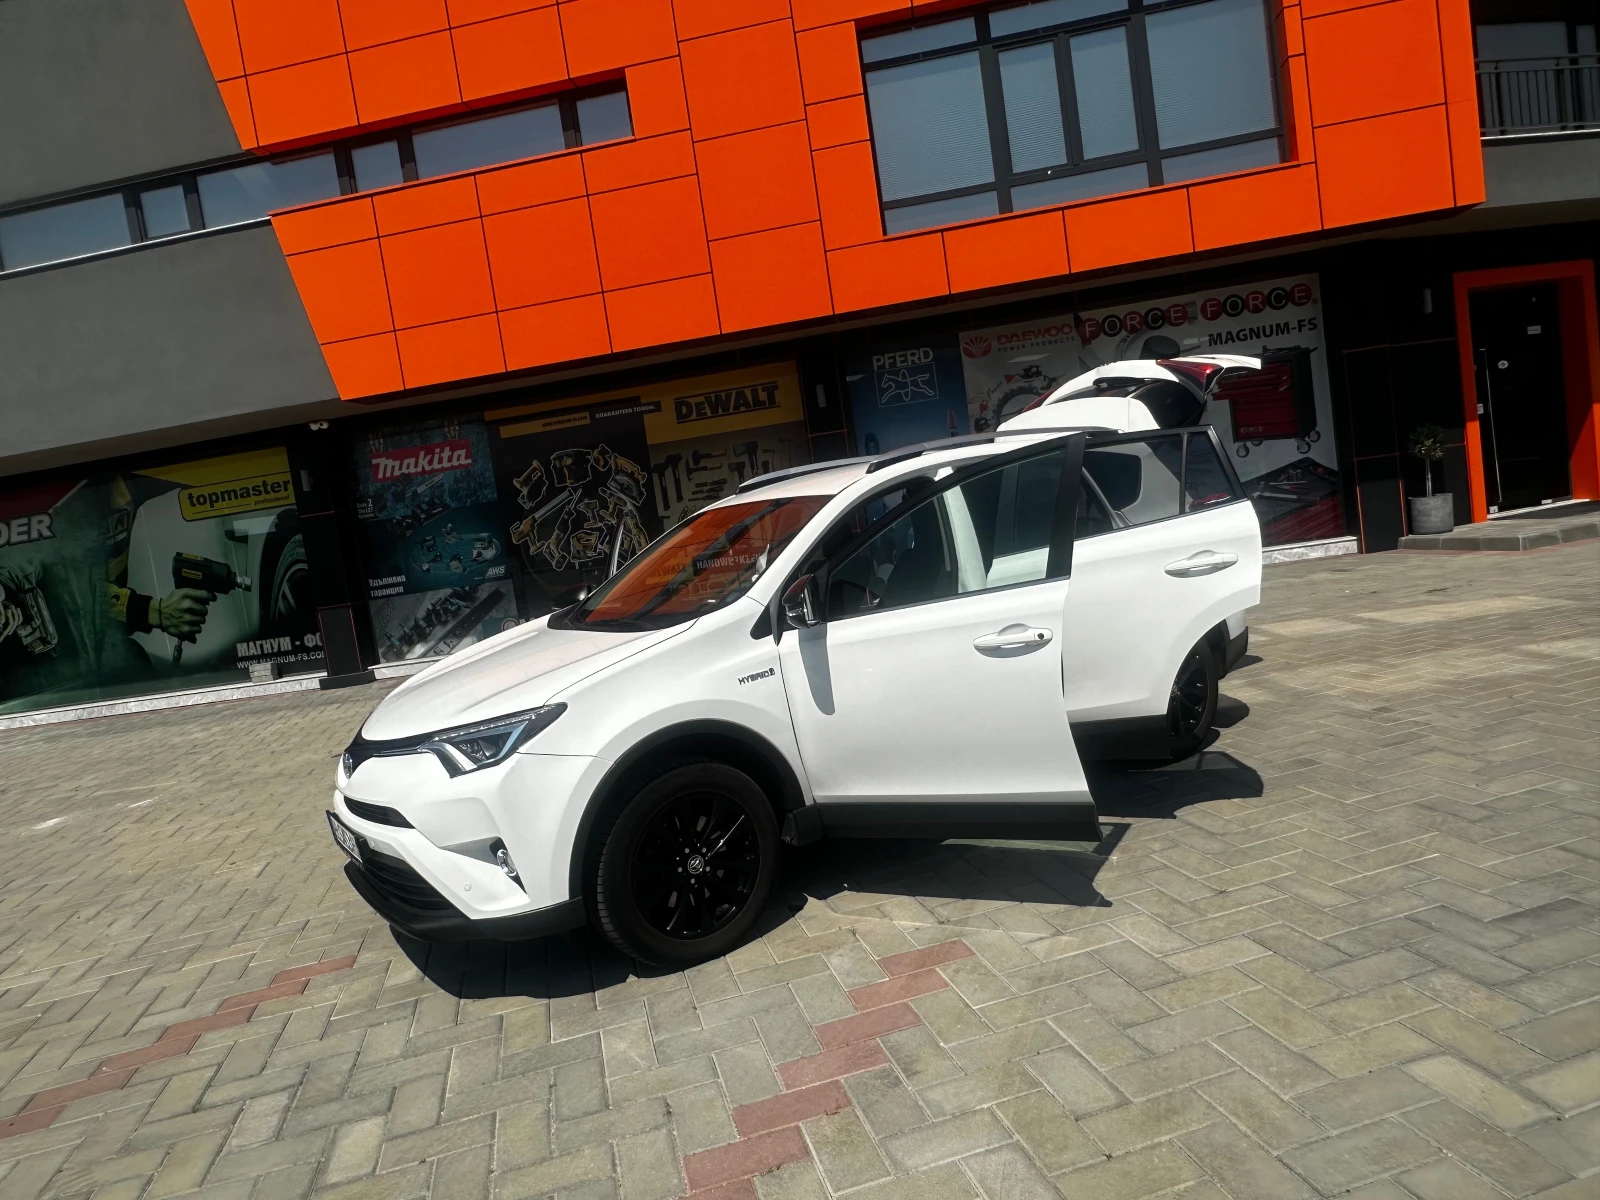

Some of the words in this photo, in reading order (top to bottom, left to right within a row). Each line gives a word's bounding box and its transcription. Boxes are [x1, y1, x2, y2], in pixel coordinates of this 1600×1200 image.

[1203, 286, 1310, 320] FORCE
[1082, 305, 1188, 340] FORCE
[1208, 317, 1318, 347] MAGNUM-FS
[996, 323, 1074, 346] DAEWOO
[998, 344, 1026, 353] POWER
[1031, 336, 1075, 348] PRODUCTS
[872, 347, 934, 371] PFERD
[187, 480, 291, 508] topmaster
[254, 494, 290, 506] professional
[487, 565, 506, 576] AWS
[236, 636, 293, 657] МАГНУМ
[236, 650, 325, 669] WWWMAGNUM-FS.CO
[737, 669, 770, 685] HYBRID
